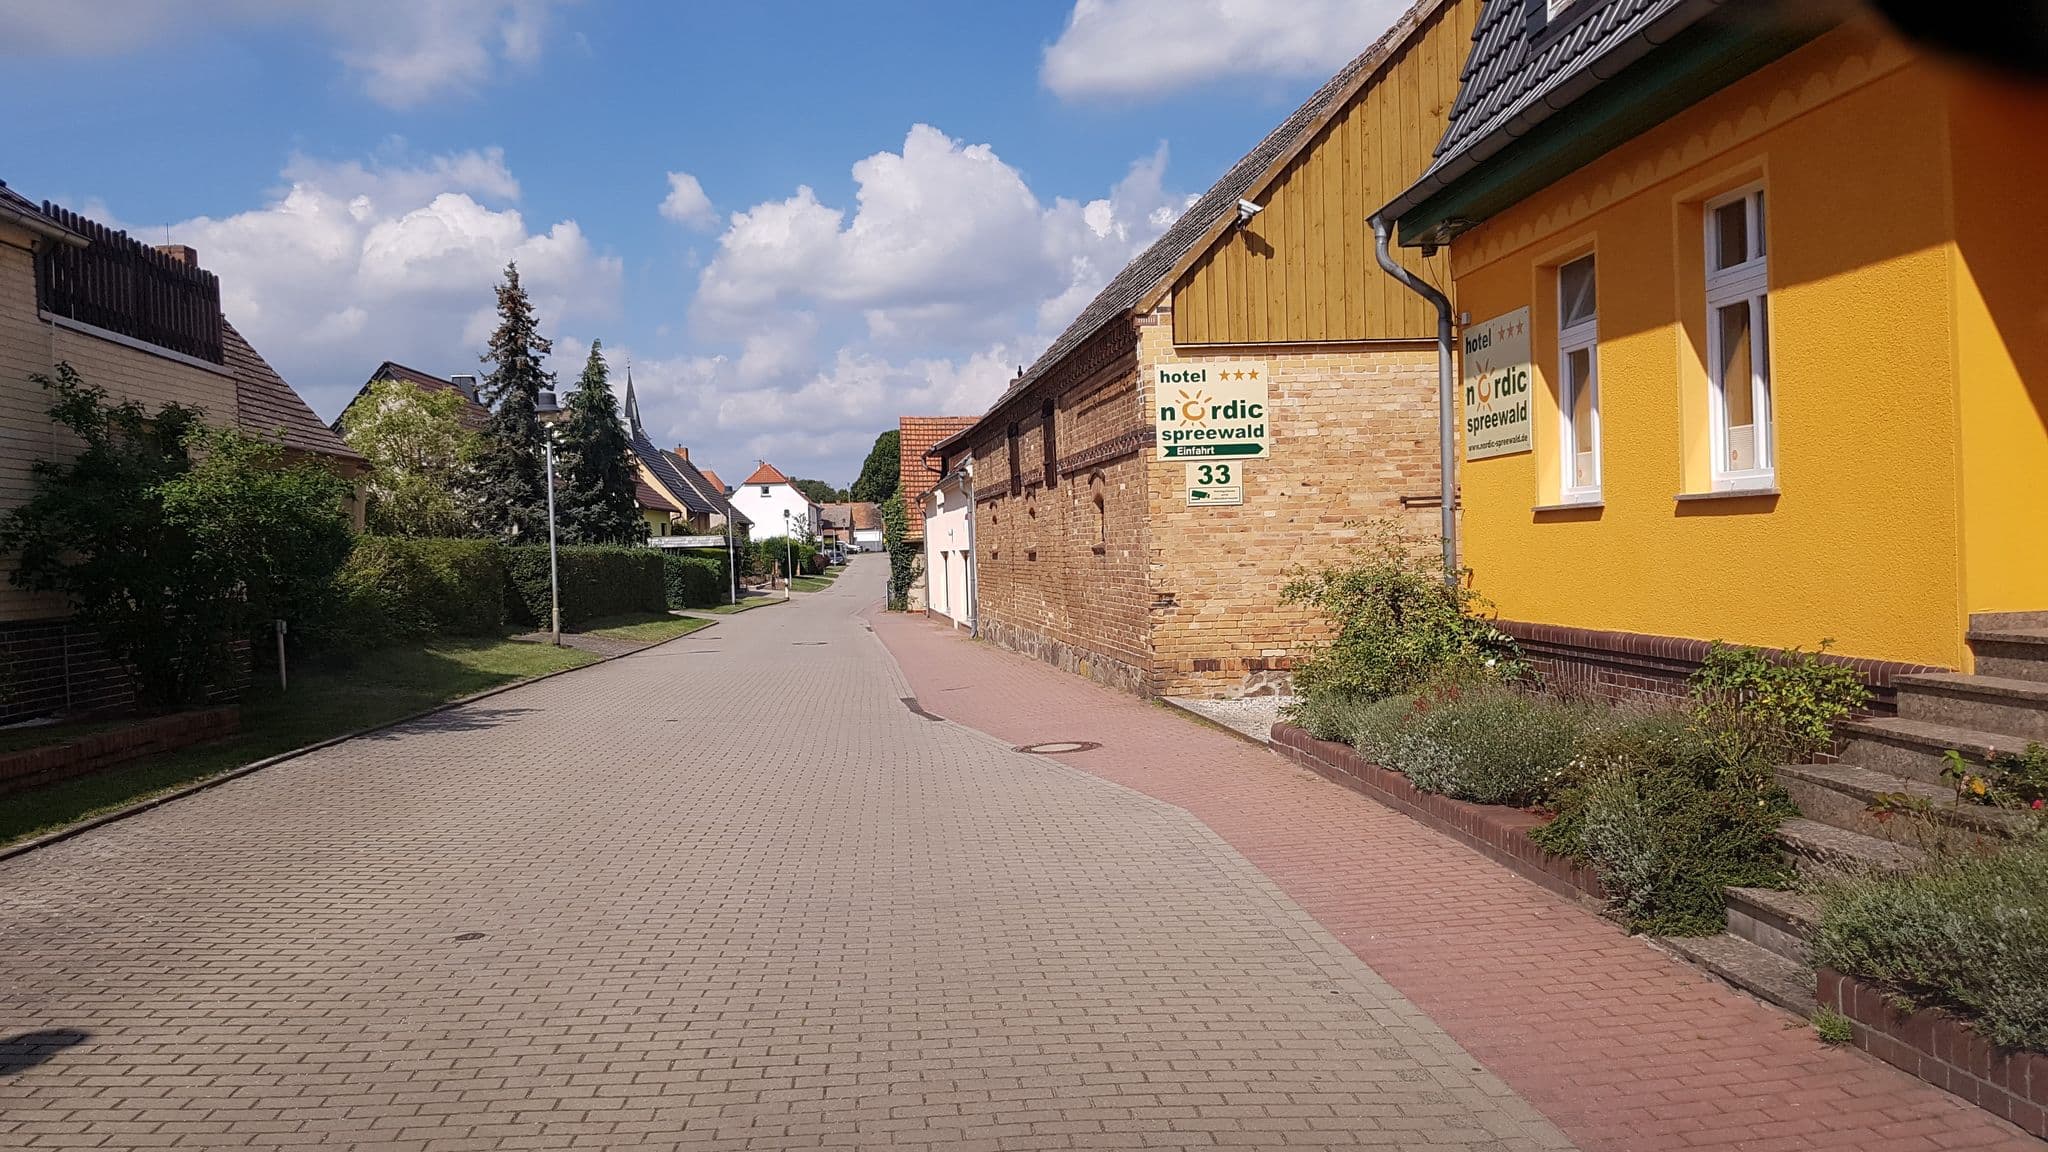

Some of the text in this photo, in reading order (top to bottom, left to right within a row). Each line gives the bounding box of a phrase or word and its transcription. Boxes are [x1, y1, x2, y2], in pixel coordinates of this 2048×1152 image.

[1465, 328, 1492, 355] hotel
[1160, 369, 1206, 383] hotel
[1467, 400, 1527, 436] spreewald
[1161, 424, 1264, 444] spreewald
[1468, 434, 1528, 452] www.nordic-spreewald.de
[1176, 446, 1215, 456] Einfahrt
[1197, 464, 1231, 485] 33
